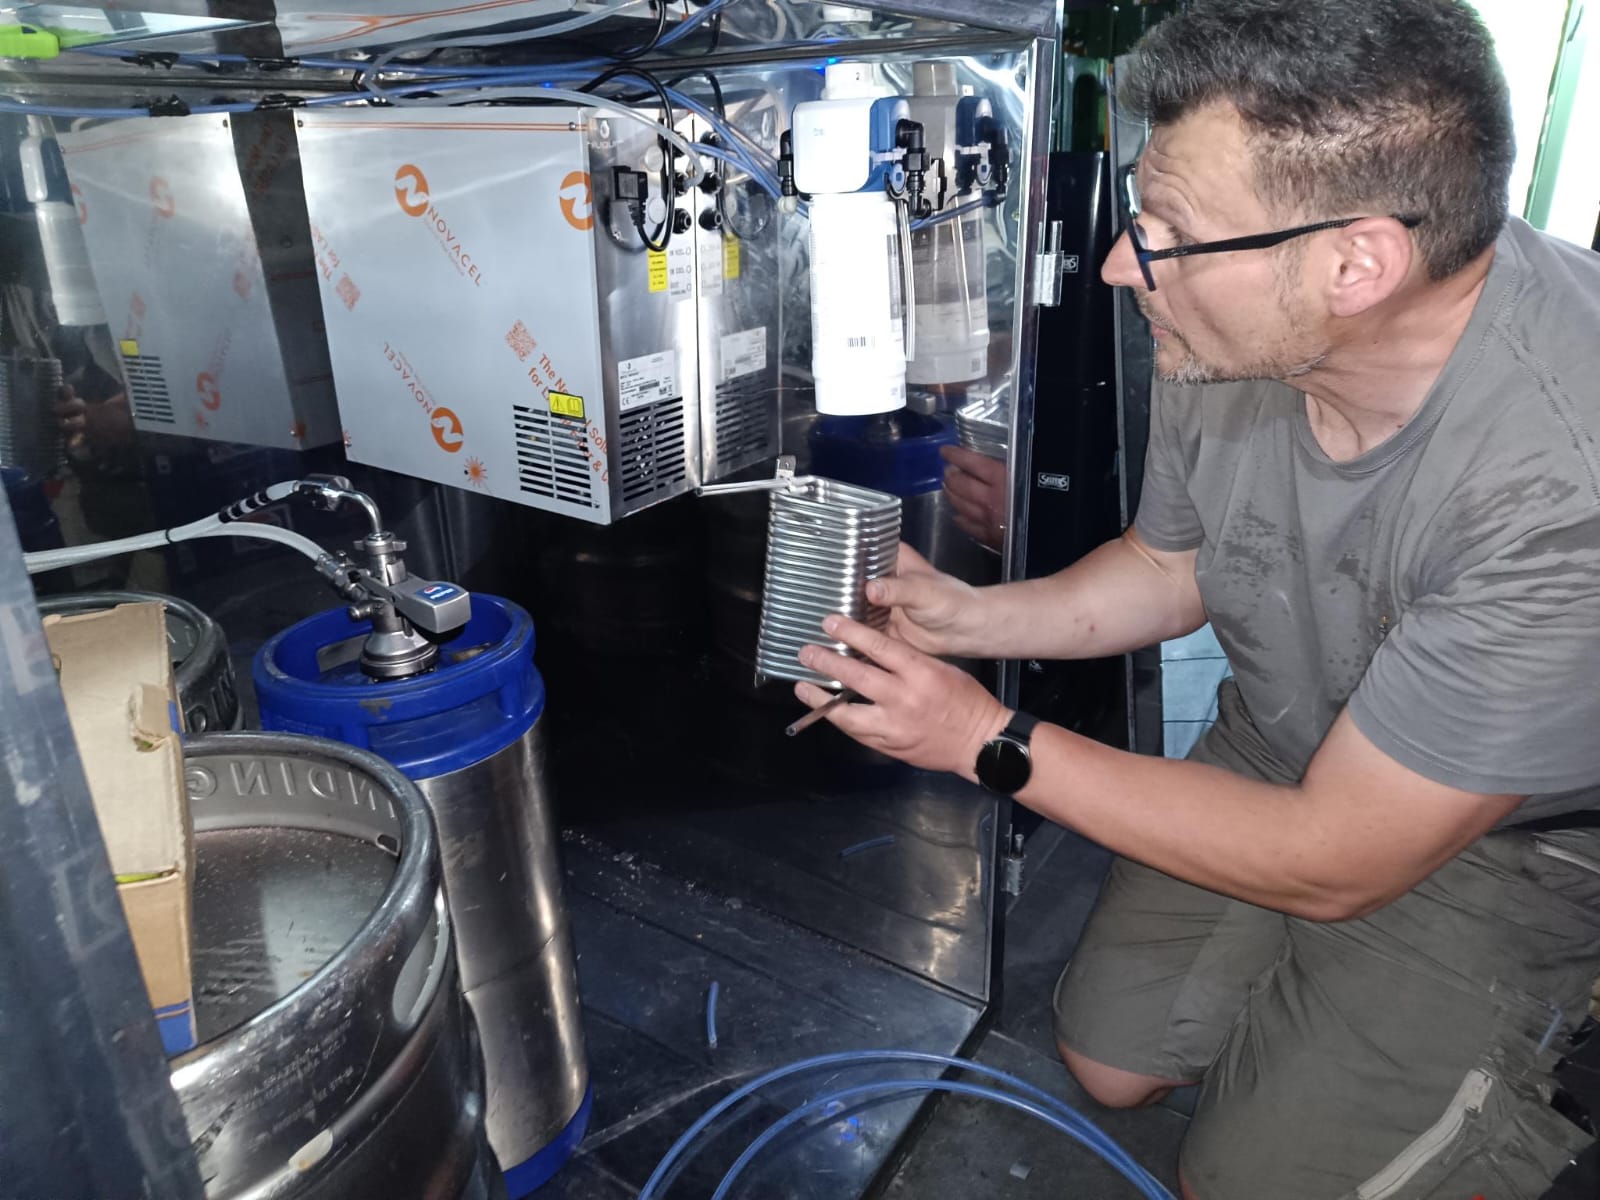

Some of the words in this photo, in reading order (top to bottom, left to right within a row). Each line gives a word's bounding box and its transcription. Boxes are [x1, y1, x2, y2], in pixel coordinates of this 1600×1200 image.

[427, 206, 482, 287] NOVACEL
[383, 341, 433, 415] NOVACEL
[528, 366, 543, 388] for
[539, 353, 555, 380] The
